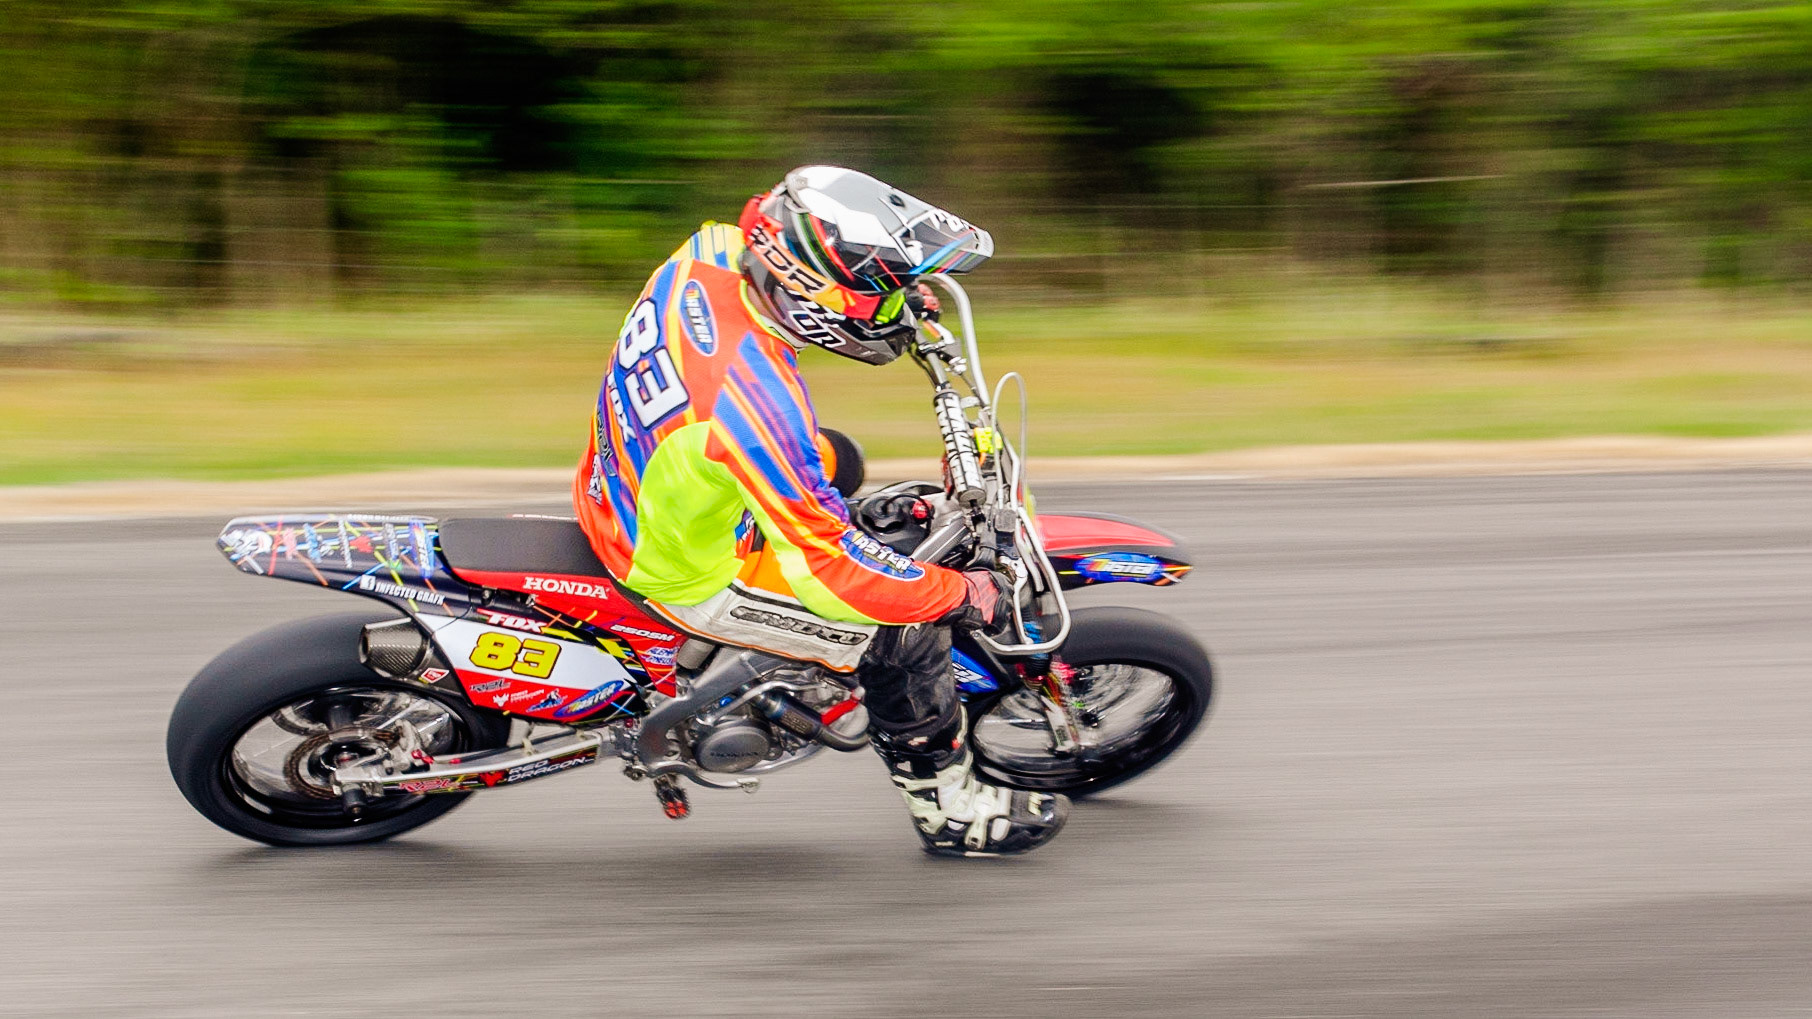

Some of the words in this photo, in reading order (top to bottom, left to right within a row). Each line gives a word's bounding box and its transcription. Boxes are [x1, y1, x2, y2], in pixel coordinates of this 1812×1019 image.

[617, 298, 690, 430] 83
[375, 582, 416, 599] INFECTED
[416, 590, 446, 605] GRAFX
[523, 576, 607, 600] HONDA
[485, 611, 547, 633] FOX
[610, 624, 675, 641] 250SM
[469, 631, 562, 679] 83
[507, 756, 587, 782] DRAGON
[509, 759, 549, 775] RED
